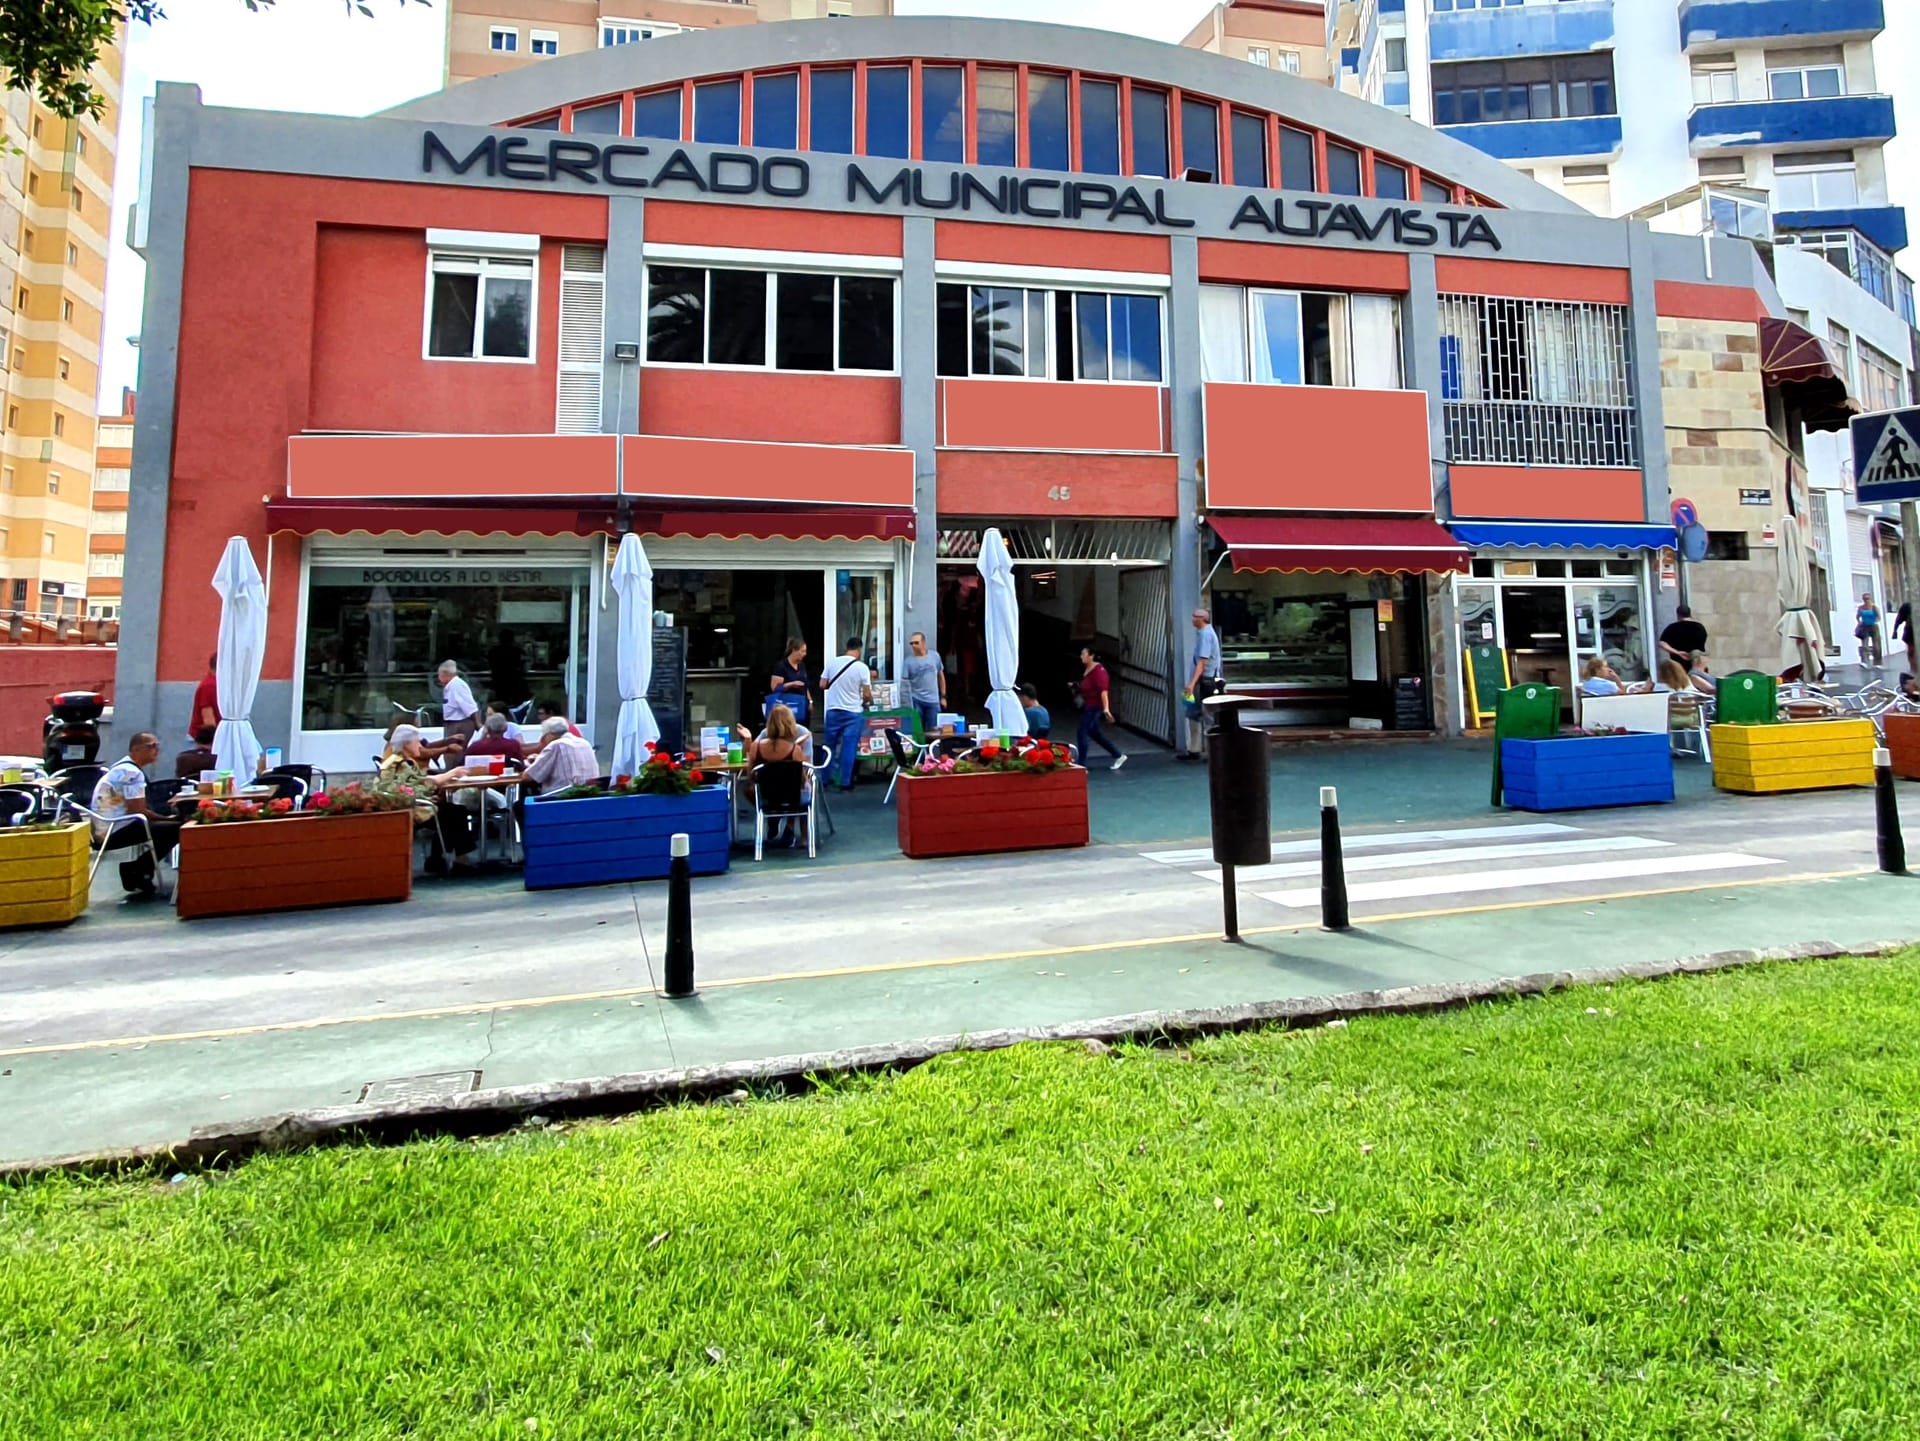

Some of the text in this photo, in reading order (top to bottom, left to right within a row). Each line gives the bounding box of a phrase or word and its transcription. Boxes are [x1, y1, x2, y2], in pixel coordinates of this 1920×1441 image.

[423, 130, 1502, 251] MERCADO MUNICIPAL ALTAVISTA
[1047, 484, 1071, 501] 45
[363, 569, 543, 583] BOCADILLOS A LO BESTIA
